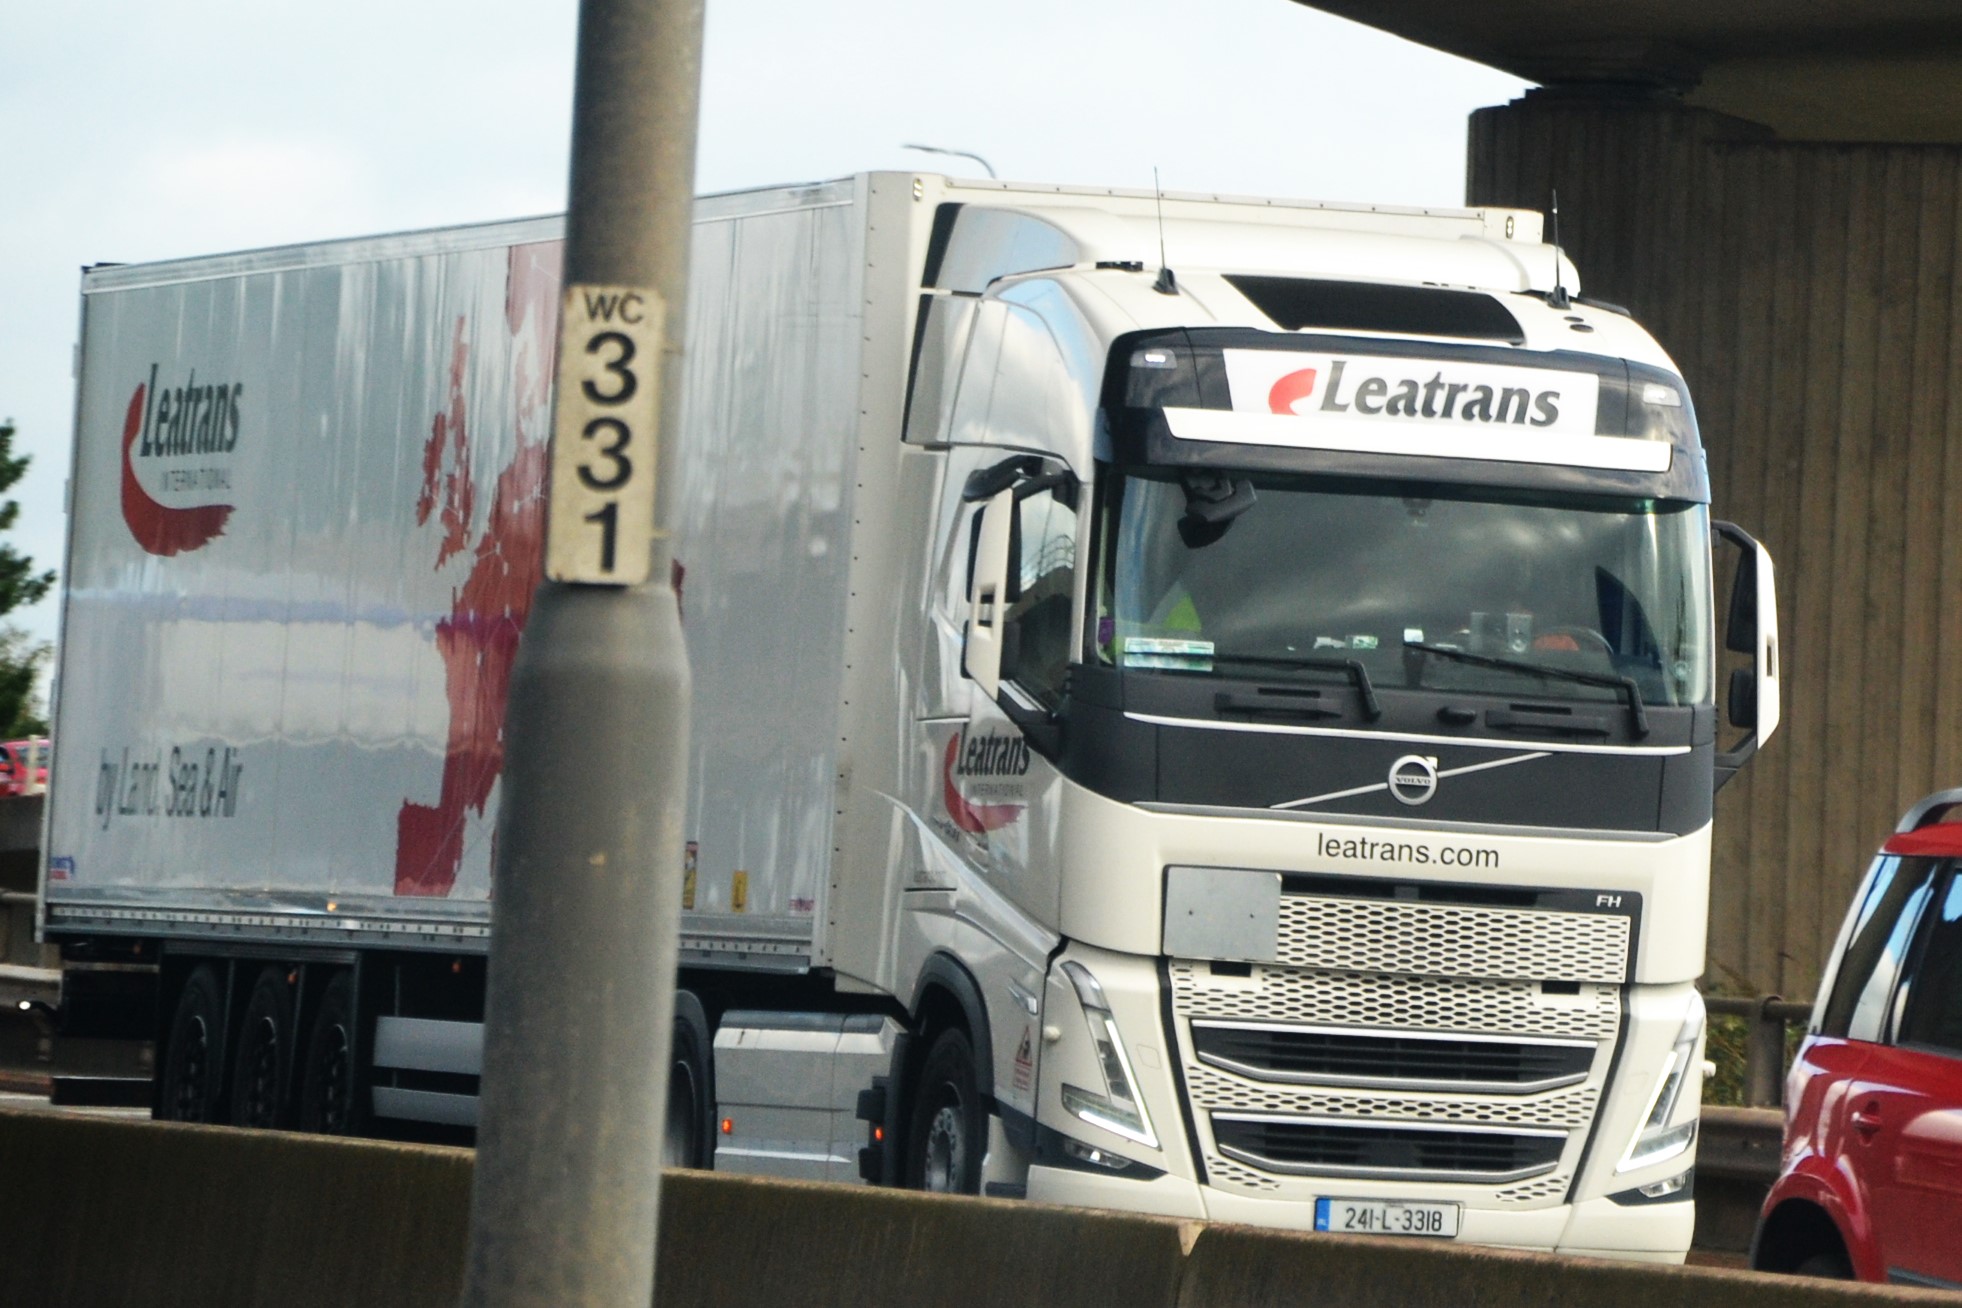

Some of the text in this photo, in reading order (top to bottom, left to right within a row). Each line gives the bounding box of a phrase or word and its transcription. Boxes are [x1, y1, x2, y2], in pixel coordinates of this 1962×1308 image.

[583, 291, 645, 325] WC
[139, 362, 243, 458] Leatrans
[1319, 359, 1562, 428] Leatrans
[957, 721, 1031, 777] Leatrans
[200, 747, 215, 818] &
[1395, 776, 1431, 785] VOLVO
[1317, 832, 1500, 868] leatrans.com
[1595, 894, 1622, 908] FH
[1344, 1206, 1443, 1233] 241-L-3318
